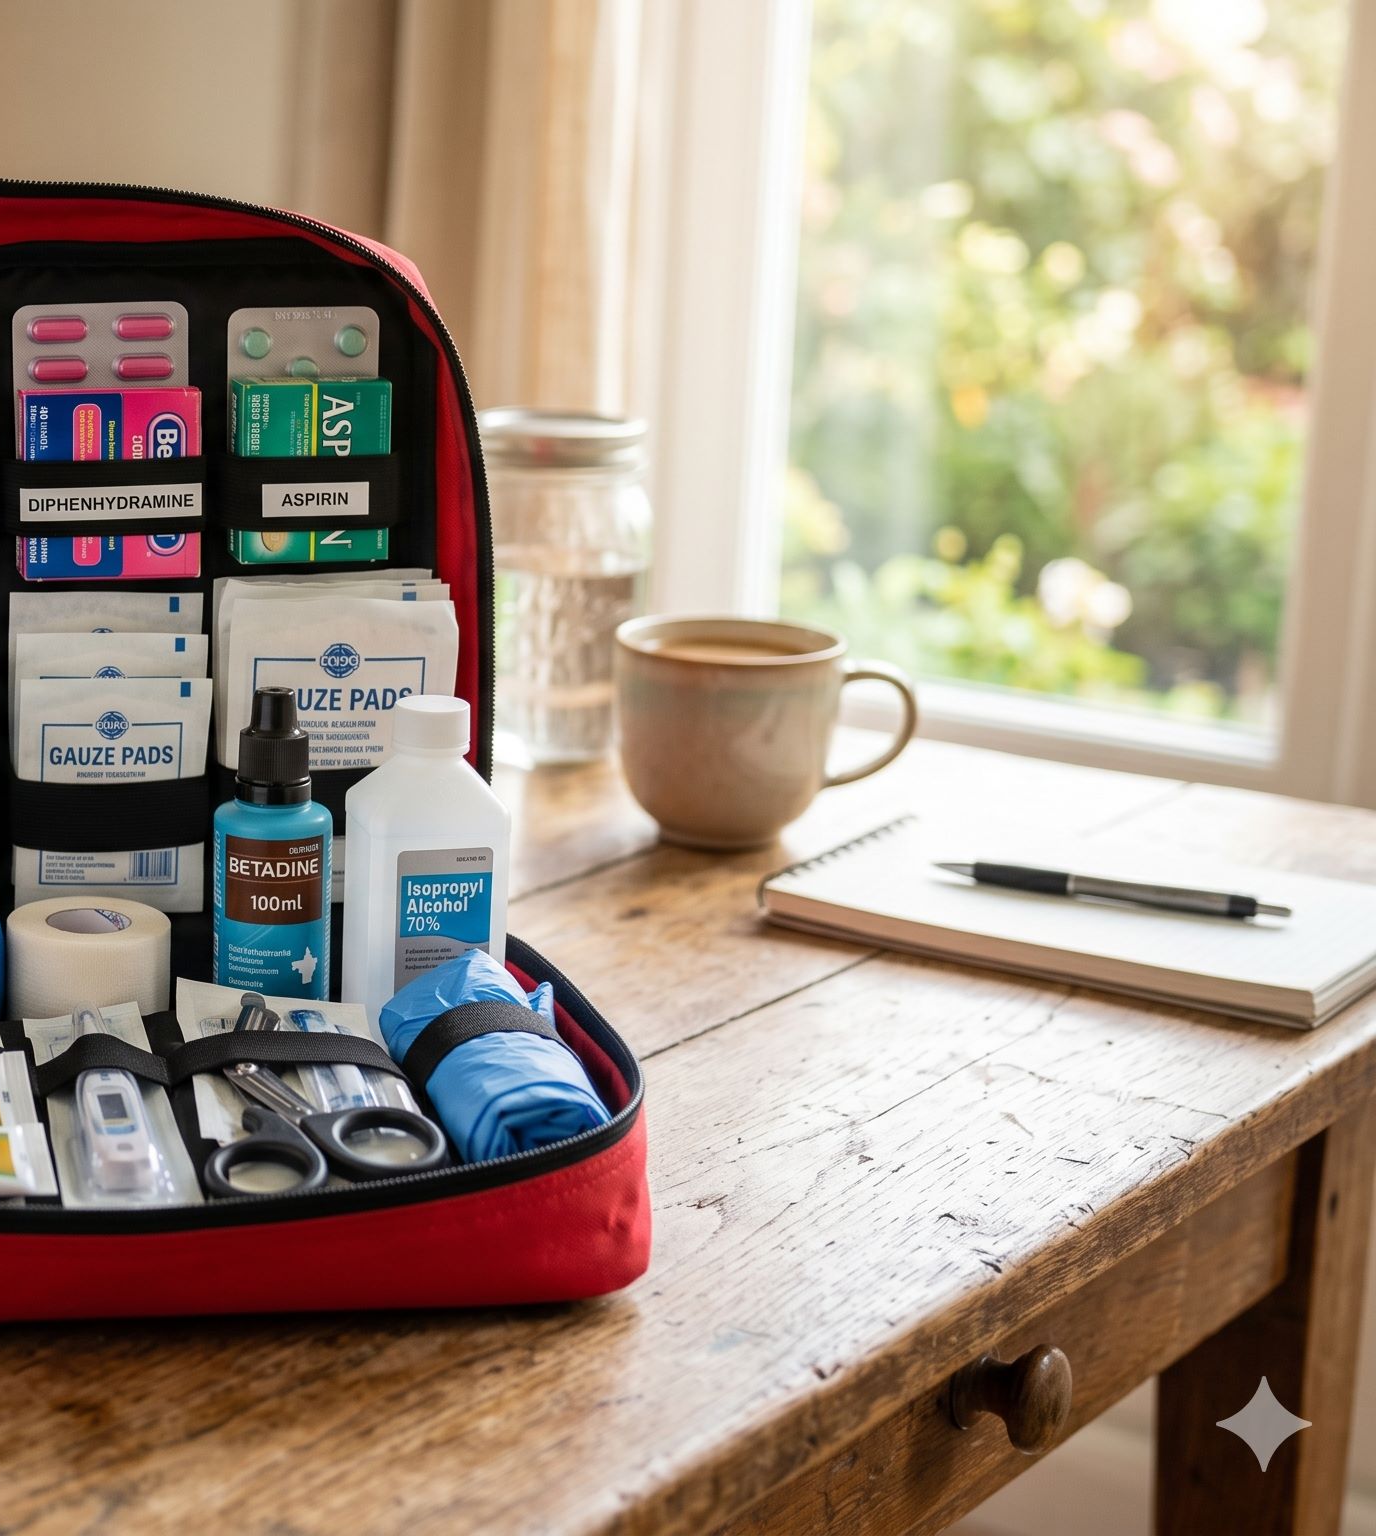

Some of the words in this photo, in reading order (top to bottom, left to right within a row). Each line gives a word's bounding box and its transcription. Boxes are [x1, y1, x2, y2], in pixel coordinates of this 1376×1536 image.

[28, 493, 195, 513] DIPHENHYDRAMINE
[281, 491, 349, 507] ASPIRIN
[296, 687, 342, 711] UZE
[49, 746, 115, 766] GAUZE
[122, 745, 174, 766] PADS
[229, 856, 319, 878] BETADINE
[407, 878, 484, 899] Isopropyl
[250, 894, 303, 911] 100ml
[406, 896, 468, 914] Alcohol
[406, 915, 441, 932] 70%
